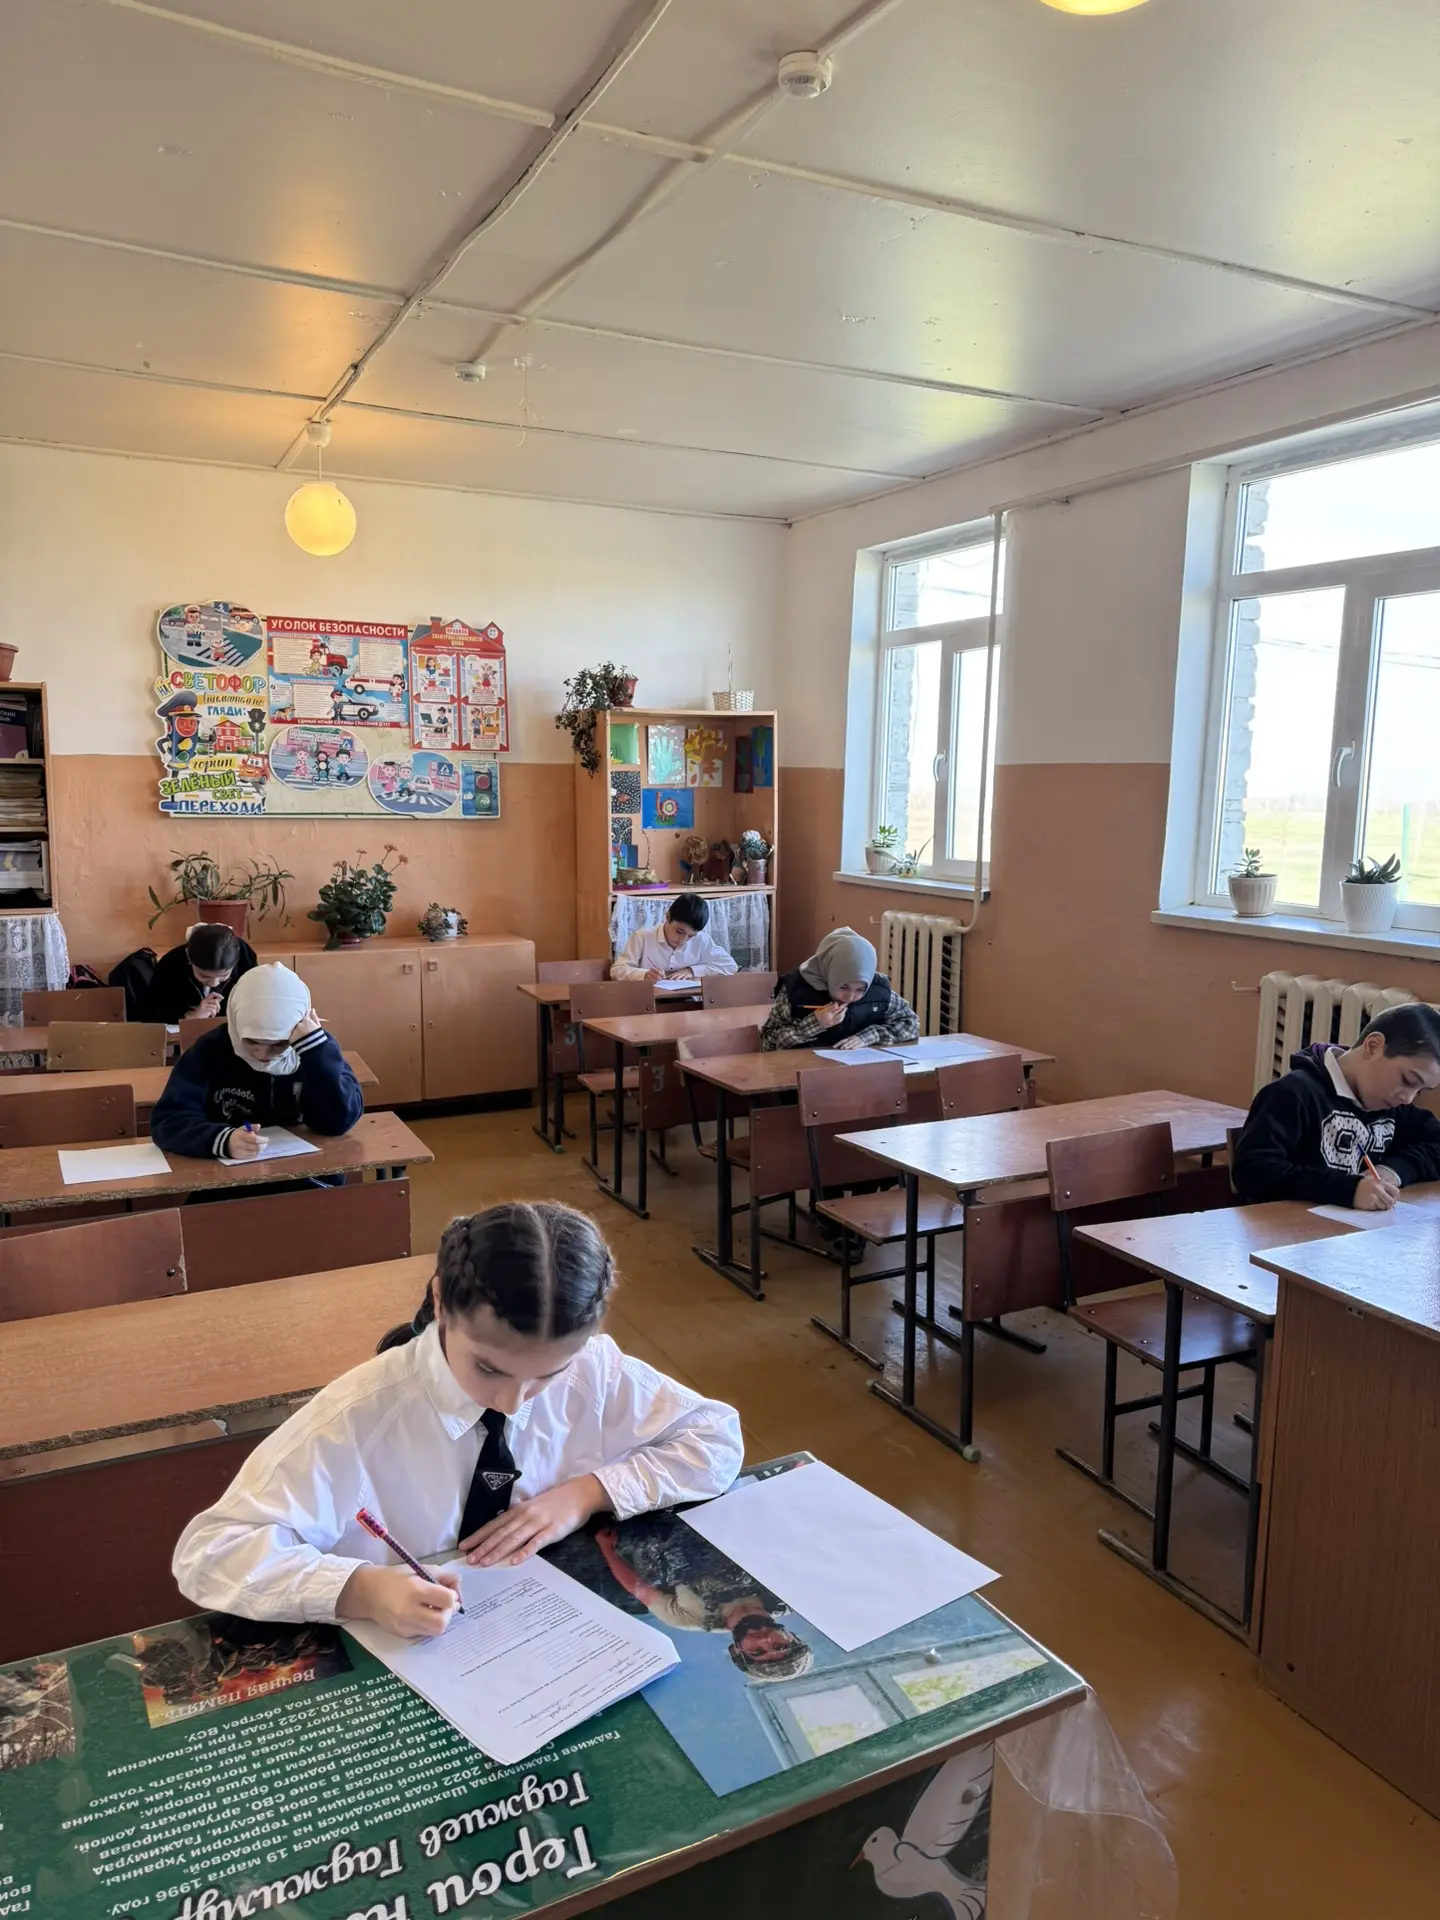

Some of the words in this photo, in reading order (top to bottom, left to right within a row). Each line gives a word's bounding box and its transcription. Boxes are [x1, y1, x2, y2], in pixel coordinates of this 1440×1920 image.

[271, 620, 316, 631] УГОЛОК
[319, 622, 405, 636] БЕЗОПАСНОСТИ
[170, 671, 266, 694] СВЕТОФОР
[207, 706, 247, 716] ГЛЯДИ:
[193, 758, 233, 773] горит
[160, 769, 236, 795] ЗЕЛЁНЫЙ
[212, 788, 243, 800] СВЕТ
[179, 797, 266, 813] ПЕРЕХОДИ!
[564, 1022, 577, 1046] 3
[652, 1065, 665, 1092] 3
[243, 1669, 315, 1697] Вечная
[361, 1671, 397, 1686] олга,
[315, 1684, 358, 1702] попав
[406, 1698, 424, 1708] на
[278, 1694, 362, 1726] 19.10.2022
[284, 1698, 312, 1711] под
[222, 1707, 282, 1730] обстрел
[306, 1705, 363, 1728] патриот
[386, 1718, 396, 1726] и
[397, 1713, 446, 1735] олным
[240, 1721, 274, 1736] года
[256, 1724, 302, 1745] своей
[300, 1724, 344, 1741] Такие
[208, 1733, 236, 1746] при
[251, 1738, 295, 1757] слова
[318, 1737, 336, 1748] но
[429, 1738, 447, 1749] на
[561, 1730, 621, 1756] Гаджиев
[107, 1742, 203, 1777] исполнении
[218, 1753, 246, 1768] мог
[266, 1745, 313, 1765] лучше
[285, 1731, 394, 1771] спокойствием
[340, 1739, 403, 1766] уговоры
[408, 1740, 475, 1769] ученного
[252, 1761, 261, 1770] я
[261, 1768, 281, 1779] на
[345, 1746, 425, 1780] передовой
[397, 1759, 461, 1788] военной
[468, 1752, 559, 1788] Гаджимурад
[149, 1764, 213, 1788] сказать
[216, 1774, 257, 1793] душе
[273, 1761, 336, 1788] родного
[331, 1774, 341, 1782] в
[344, 1766, 404, 1791] отпуска
[441, 1766, 481, 1786] 2022
[89, 1786, 145, 1807] только
[144, 1789, 174, 1803] как
[222, 1785, 269, 1805] брата
[289, 1779, 327, 1796] зоне
[322, 1788, 340, 1799] за
[404, 1781, 438, 1798] года
[279, 1795, 318, 1813] свои
[317, 1783, 393, 1814] операции
[364, 1785, 468, 1827] Шахмирович
[61, 1800, 139, 1830] мужчина
[140, 1801, 217, 1830] приехать
[293, 1810, 312, 1822] на
[317, 1794, 401, 1828] находился
[418, 1772, 589, 1857] Гаджиев
[99, 1807, 241, 1859] аргументировав
[190, 1819, 289, 1857] территории
[293, 1824, 313, 1837] на
[293, 1821, 360, 1852] родился
[92, 1834, 202, 1876] Гаджимурад
[266, 1848, 288, 1863] 19
[207, 1857, 261, 1882] марта
[427, 1826, 597, 1915] Герои
[155, 1877, 202, 1902] 1996
